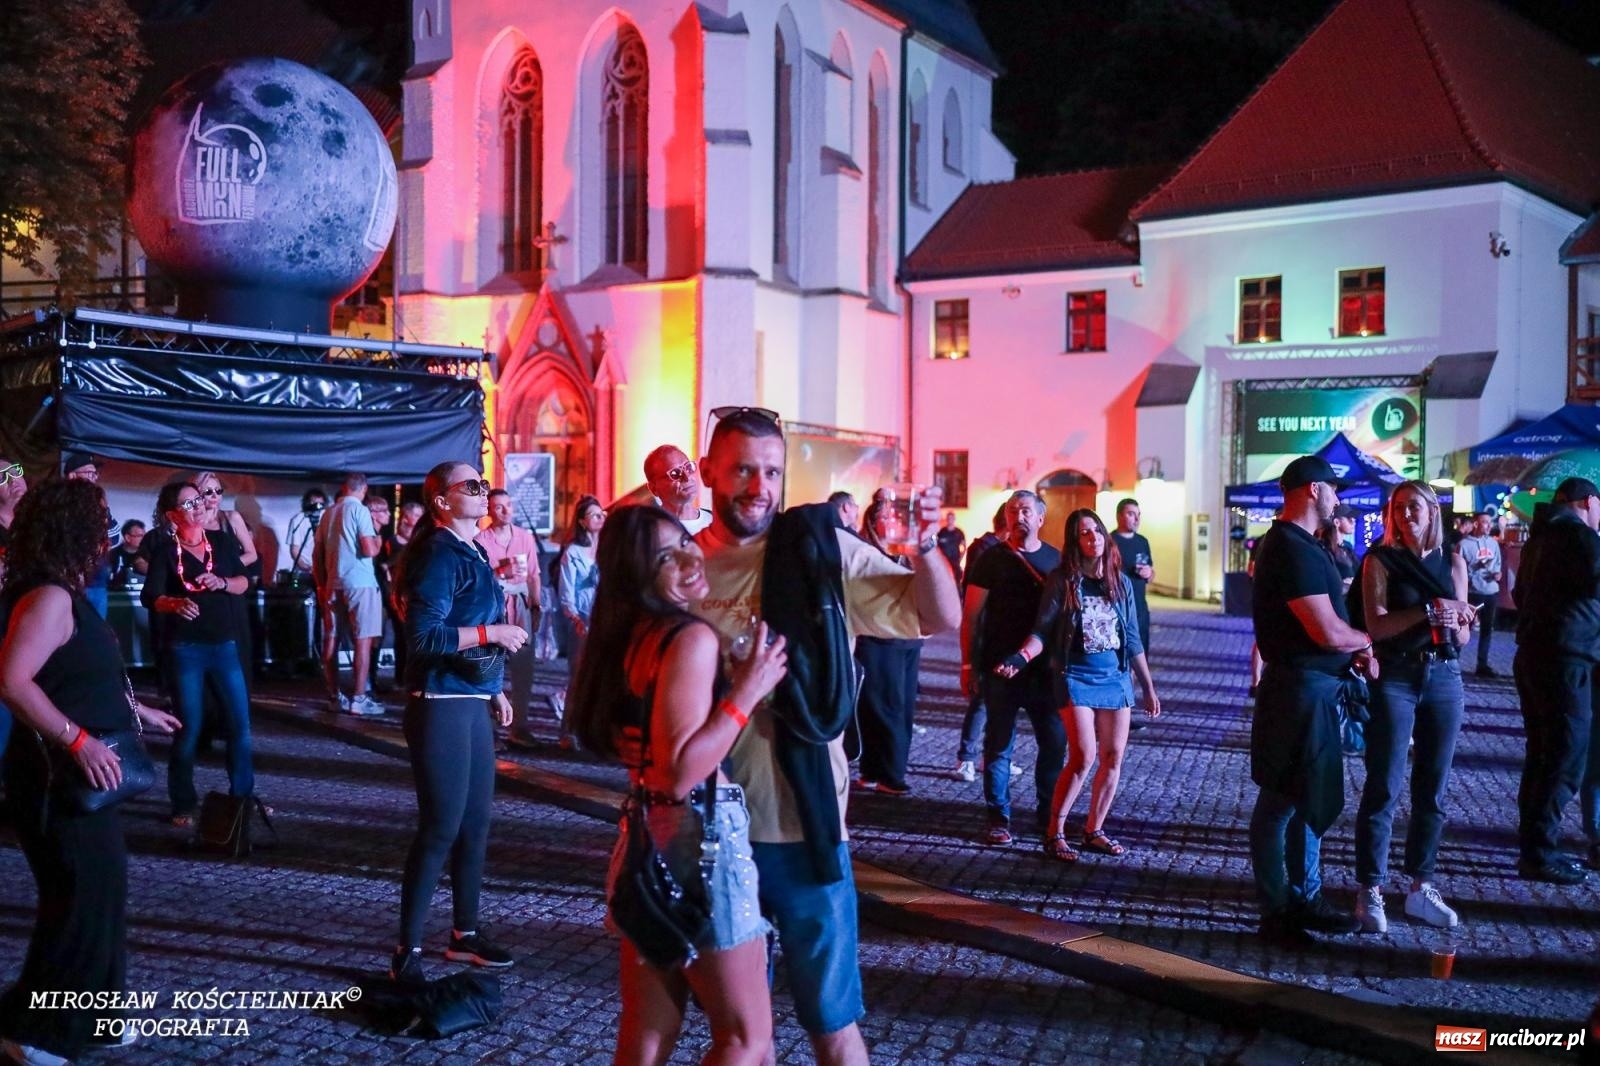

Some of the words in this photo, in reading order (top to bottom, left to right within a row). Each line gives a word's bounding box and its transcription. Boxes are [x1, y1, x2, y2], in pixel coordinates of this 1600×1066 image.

[196, 147, 242, 183] FULL
[1257, 416, 1277, 432] SEE
[1278, 416, 1299, 432] YOU
[1301, 415, 1327, 431] NEXT
[1328, 415, 1356, 431] YEAR
